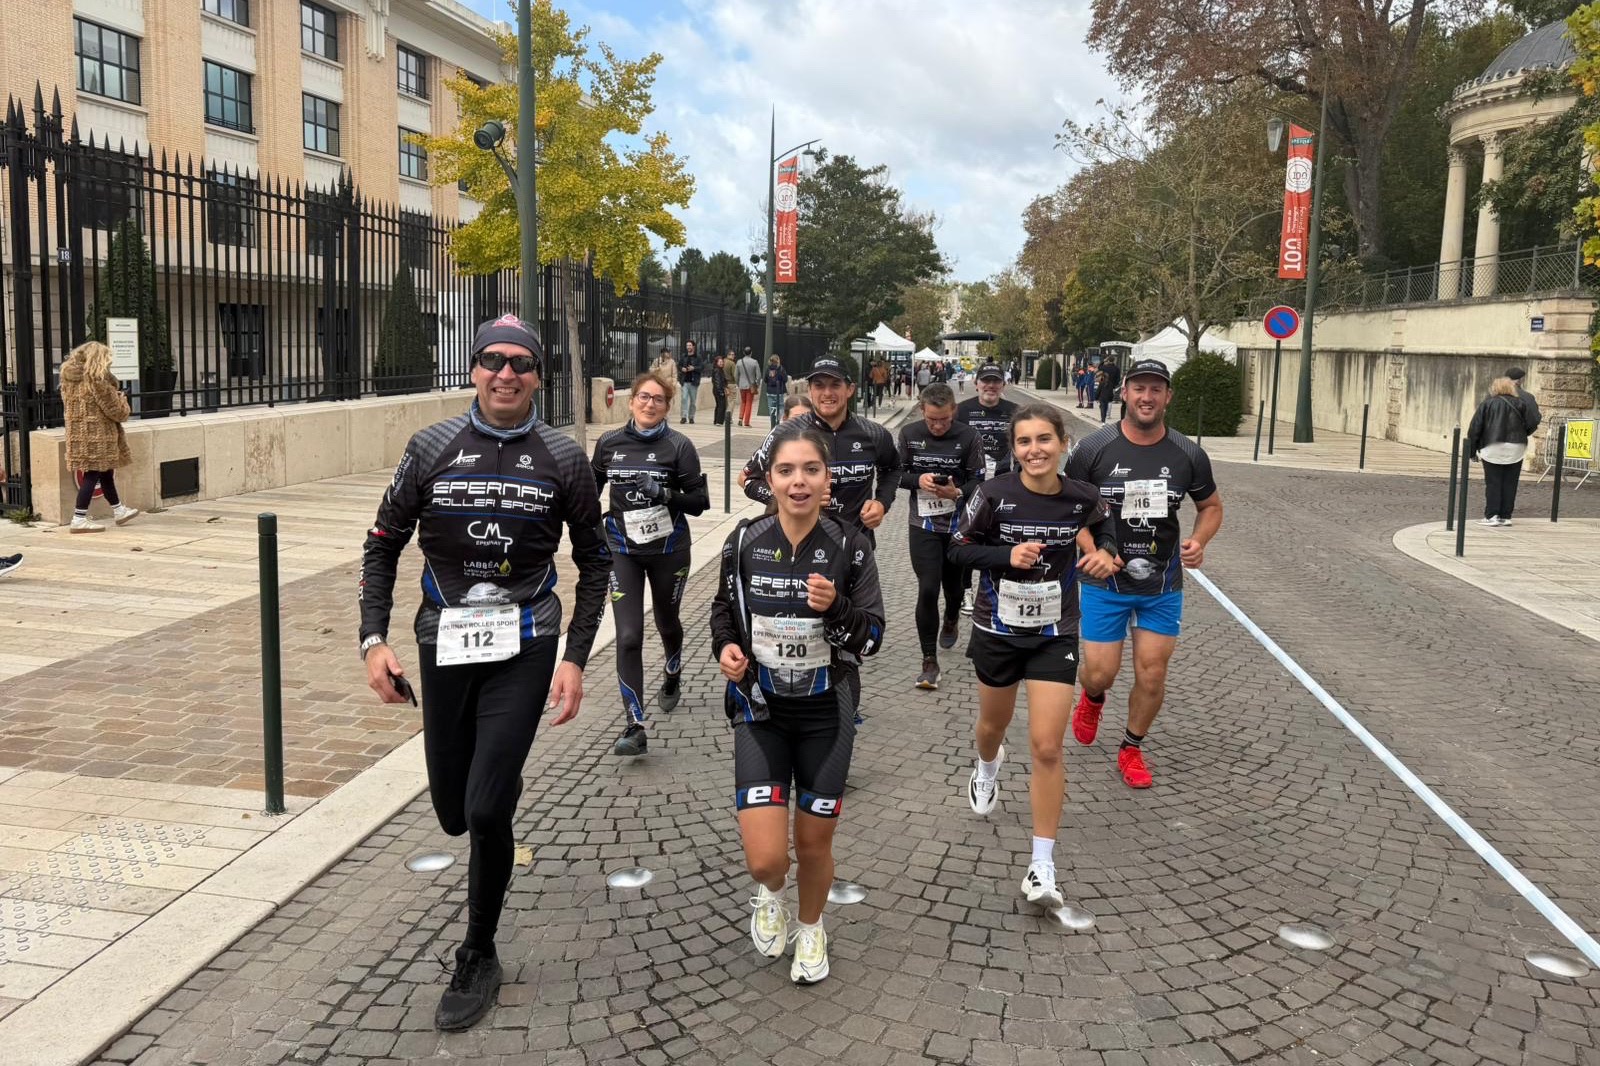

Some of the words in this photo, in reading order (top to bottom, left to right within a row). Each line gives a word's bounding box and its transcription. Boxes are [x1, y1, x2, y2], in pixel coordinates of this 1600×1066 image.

[61, 250, 70, 260] 18
[433, 481, 554, 501] EPERNAY
[432, 497, 496, 508] ROLLER
[500, 499, 551, 514] SPORT
[640, 522, 659, 535] 123
[1000, 523, 1079, 538] EPERNAY
[1018, 604, 1042, 616] 121
[469, 621, 495, 629] ROLLER
[461, 630, 494, 648] 112
[753, 630, 781, 639] EPERNAY
[776, 642, 807, 658] 120
